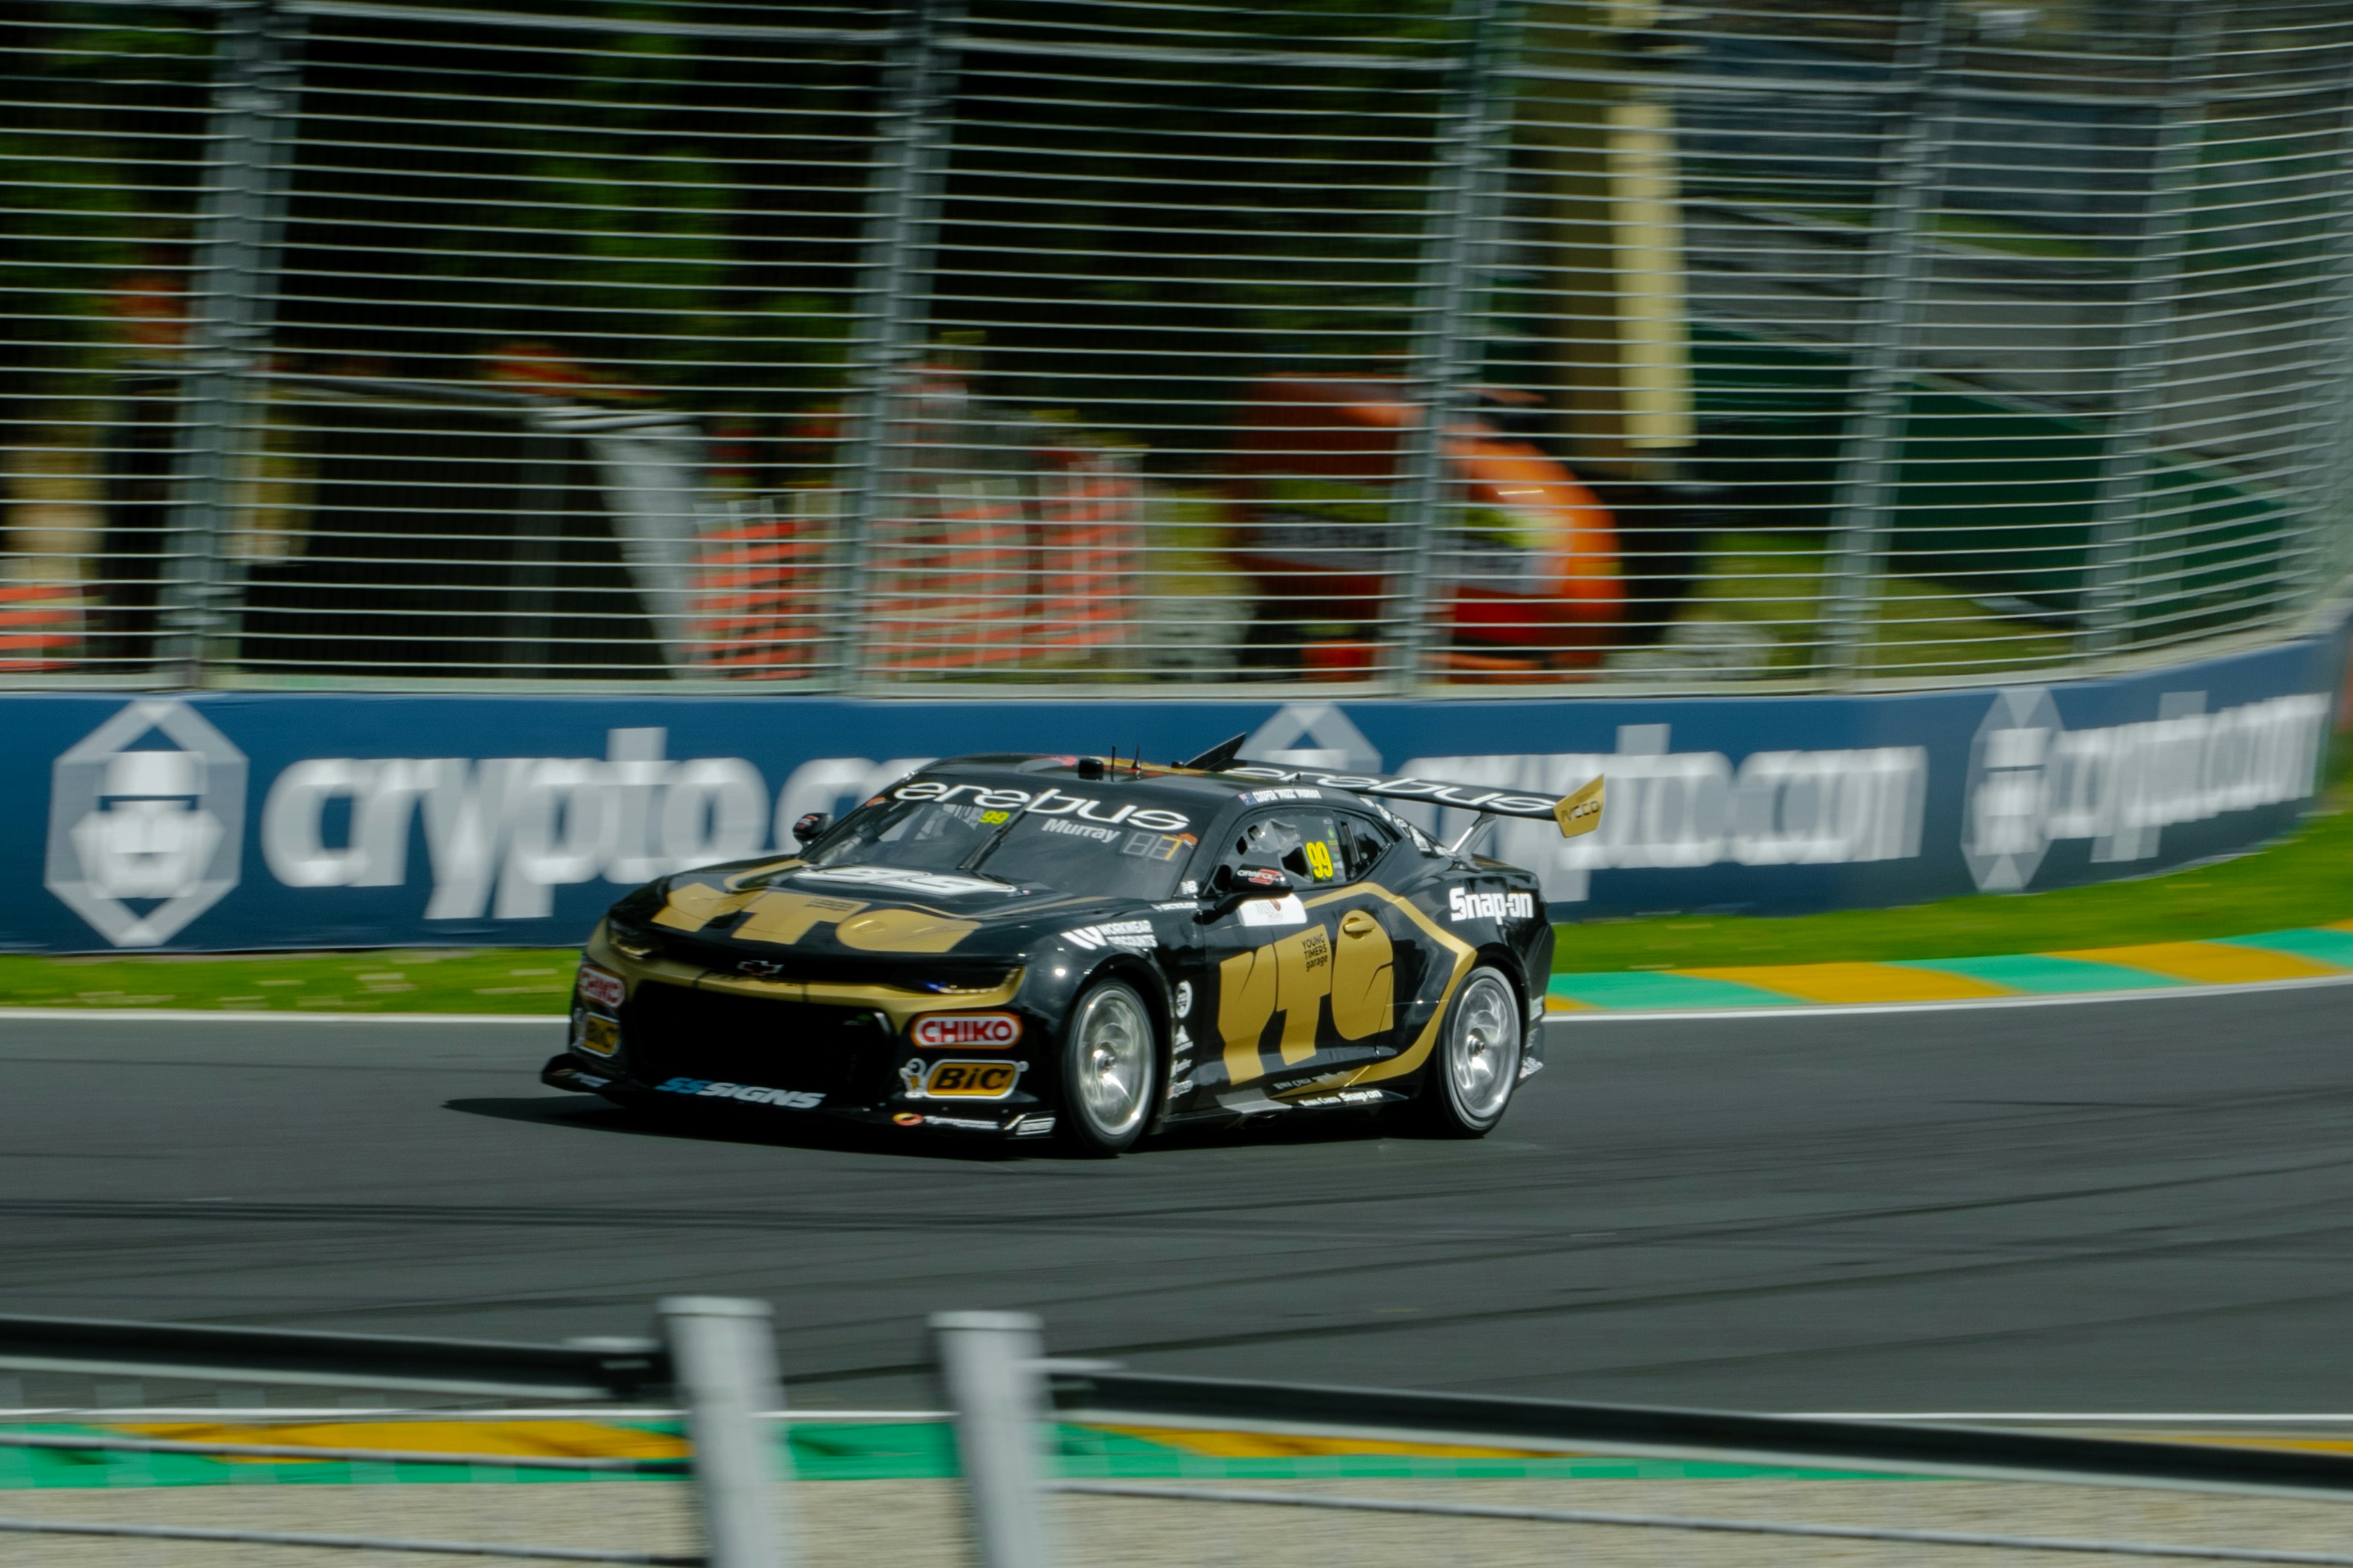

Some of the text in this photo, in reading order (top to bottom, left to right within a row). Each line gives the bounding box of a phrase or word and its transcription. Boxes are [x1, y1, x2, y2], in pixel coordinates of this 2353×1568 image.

[894, 781, 1190, 830] erebus
[979, 810, 1010, 825] 99
[1042, 819, 1121, 843] Murray
[1306, 841, 1333, 878] 99
[1449, 887, 1534, 926] Snap-on
[1301, 933, 1325, 950] YOUNG
[1306, 955, 1328, 972] garage
[921, 1020, 1013, 1043] CHIKO
